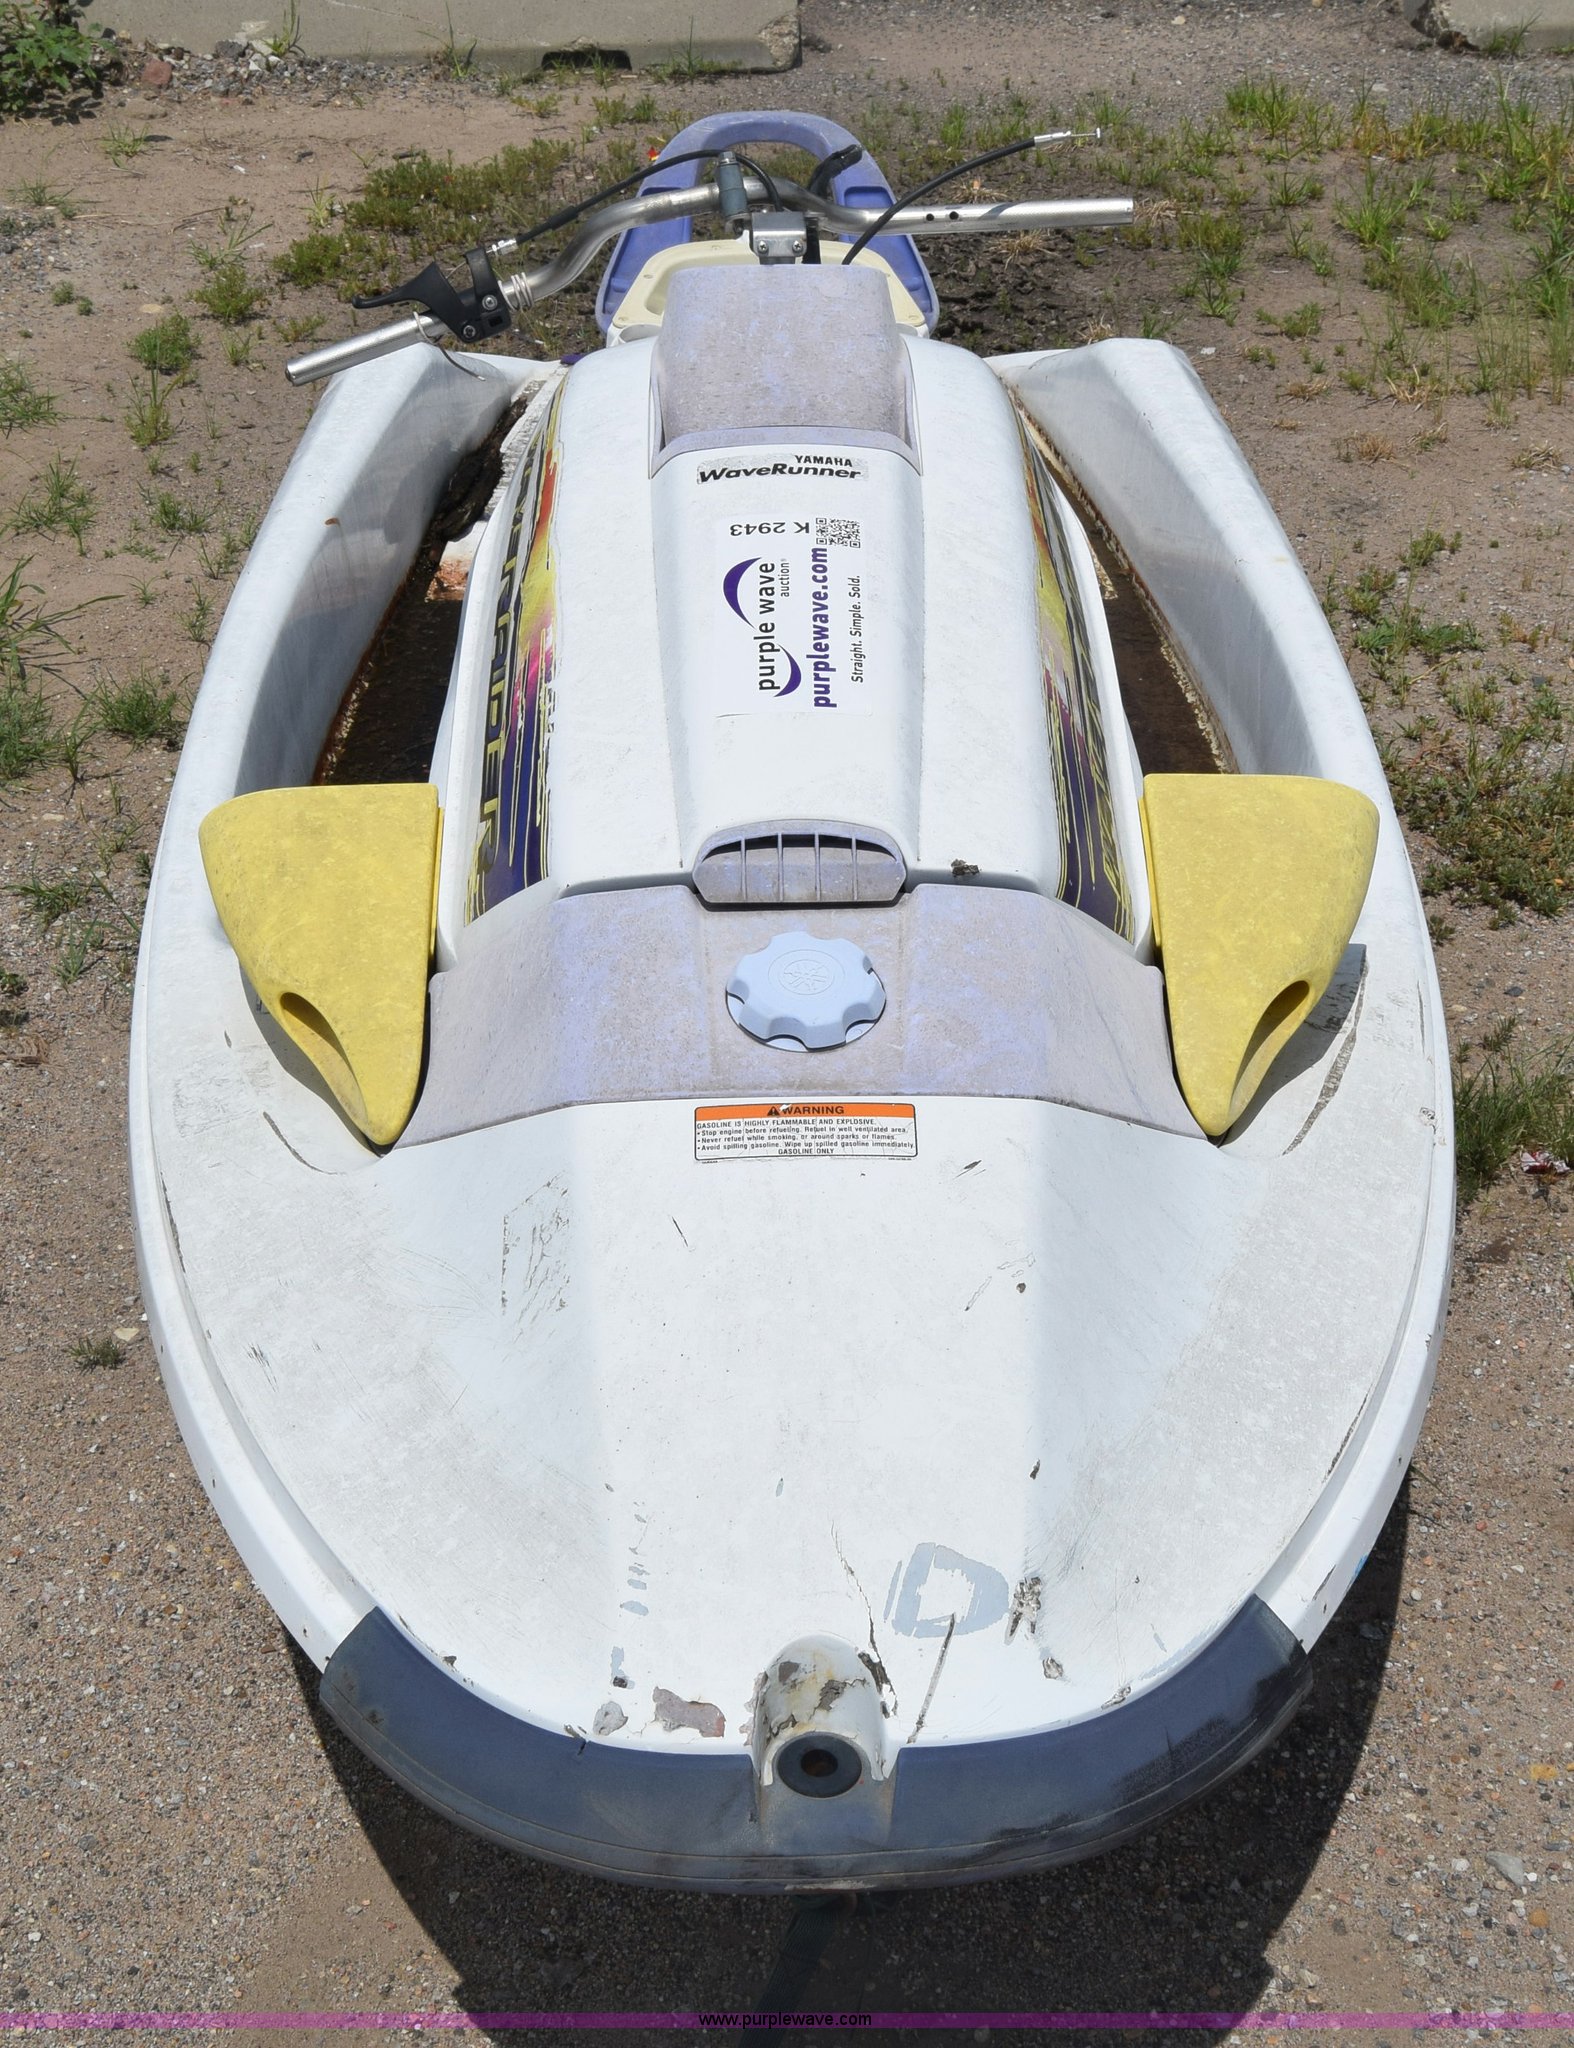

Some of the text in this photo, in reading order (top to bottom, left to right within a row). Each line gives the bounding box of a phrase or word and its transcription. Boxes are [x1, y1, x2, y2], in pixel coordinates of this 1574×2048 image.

[795, 455, 853, 467] YAMAHA
[699, 463, 861, 483] WaveRunner
[730, 522, 810, 536] K 2943
[778, 562, 790, 597] auction
[753, 562, 780, 690] purple wave
[806, 548, 837, 708] purplewave.com
[847, 575, 866, 683] Straight. Simple. Sold.
[781, 1106, 844, 1115] WARNING
[697, 1121, 731, 1129] GASOLINE
[720, 1128, 742, 1136] engine
